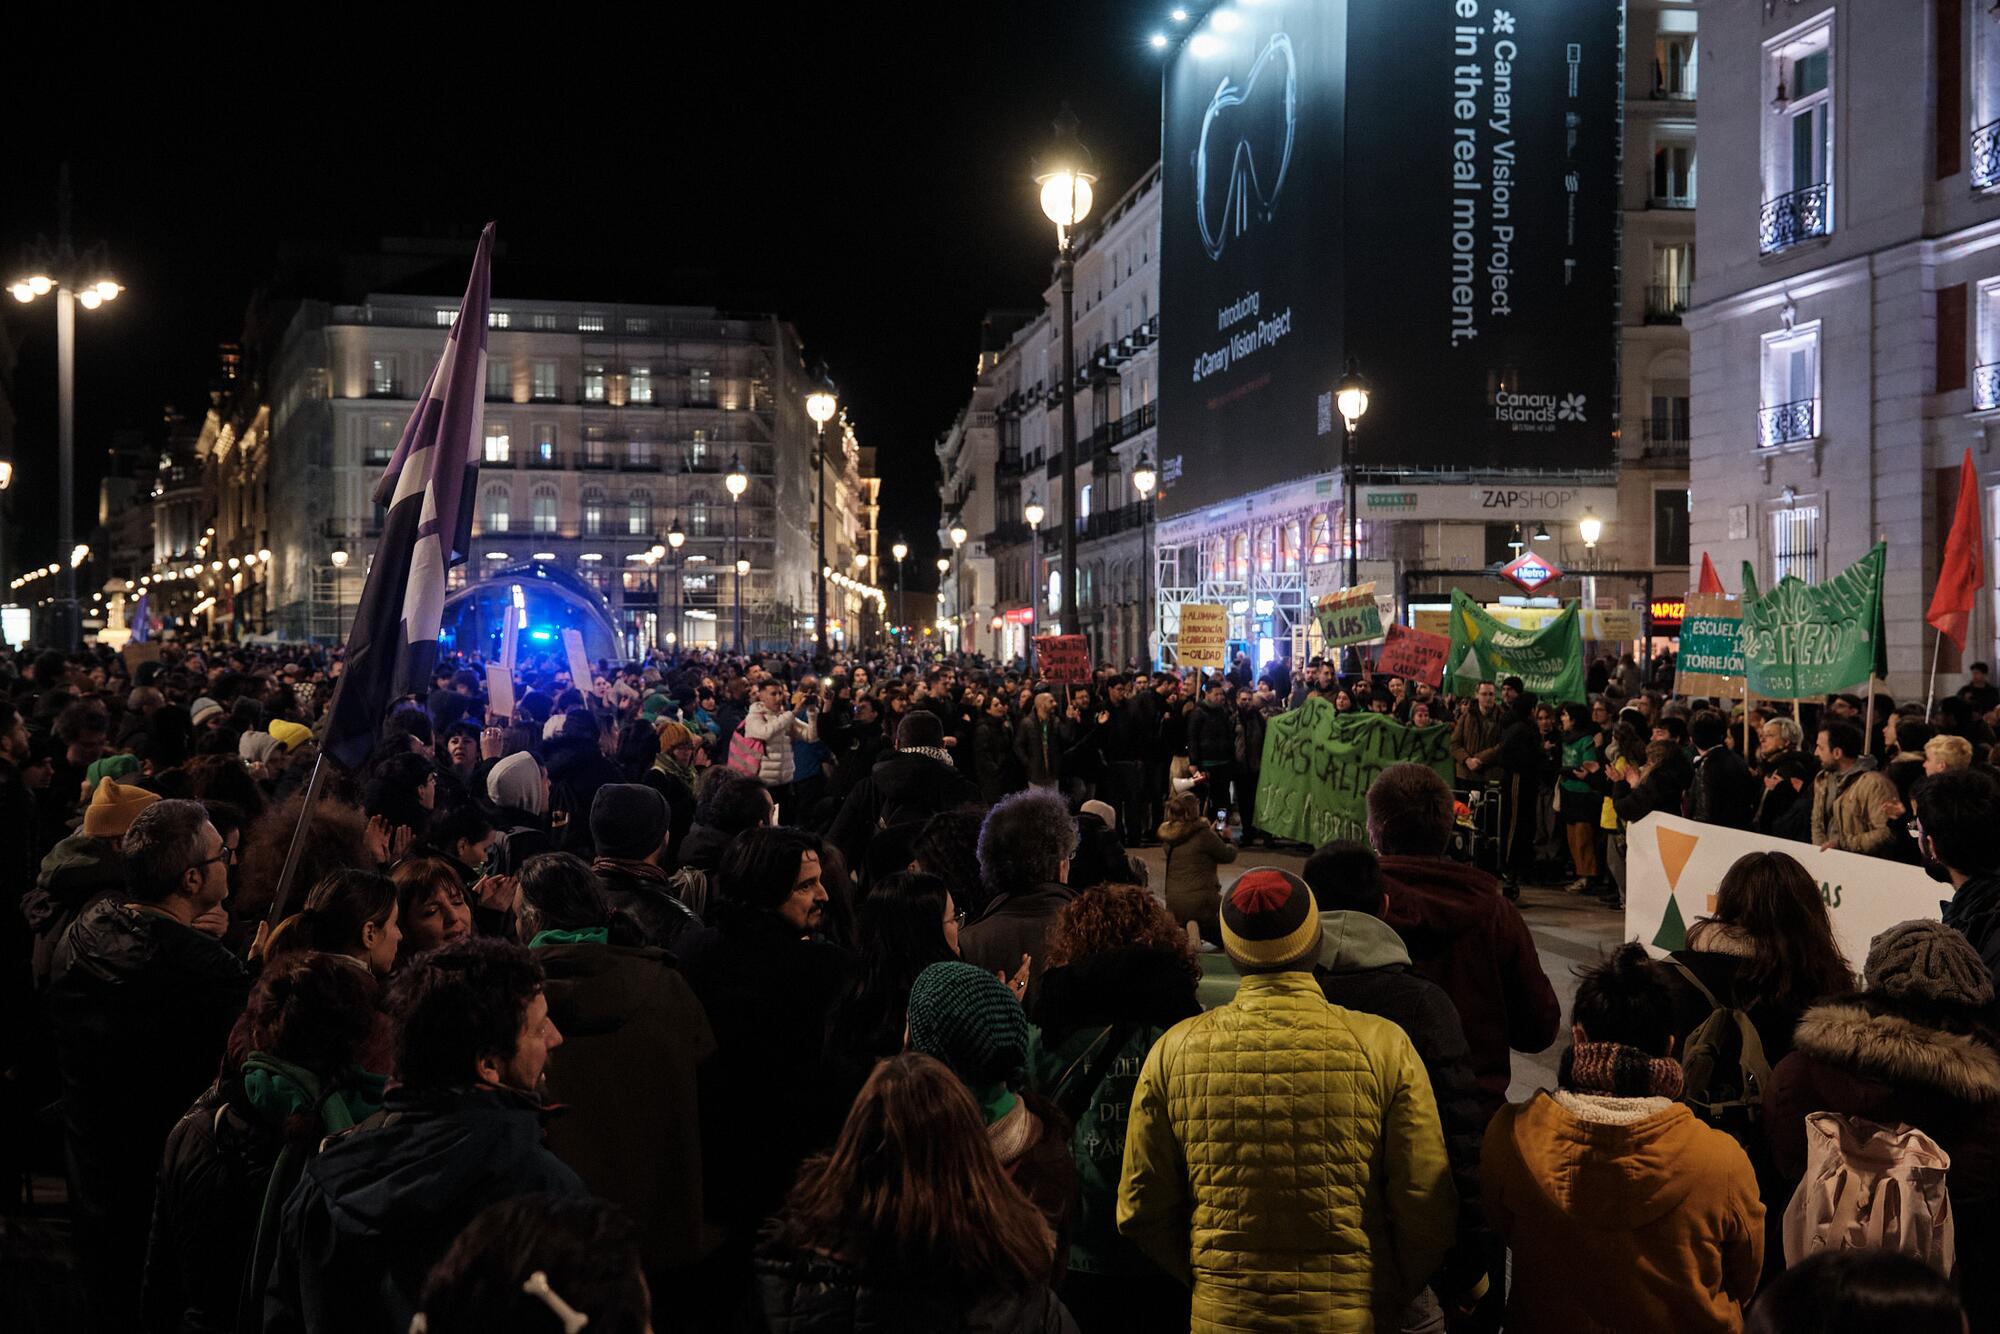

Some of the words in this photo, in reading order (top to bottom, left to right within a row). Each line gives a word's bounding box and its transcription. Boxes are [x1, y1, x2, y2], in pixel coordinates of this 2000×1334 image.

[1455, 26, 1485, 56] in
[1454, 64, 1483, 120] the
[1489, 40, 1517, 134] Canary
[1453, 128, 1482, 189] real
[1493, 140, 1515, 218] Vision
[1451, 199, 1478, 348] moment.
[1487, 226, 1514, 315] Project
[1218, 291, 1259, 331] Introducing
[1201, 345, 1230, 377] Canary
[1230, 330, 1257, 362] Vision
[1258, 306, 1291, 347] Project
[1496, 391, 1556, 410] Canary
[1496, 406, 1556, 421] Islands
[1518, 568, 1546, 578] Metro
[1327, 620, 1339, 640] A
[1339, 615, 1362, 640] LAS
